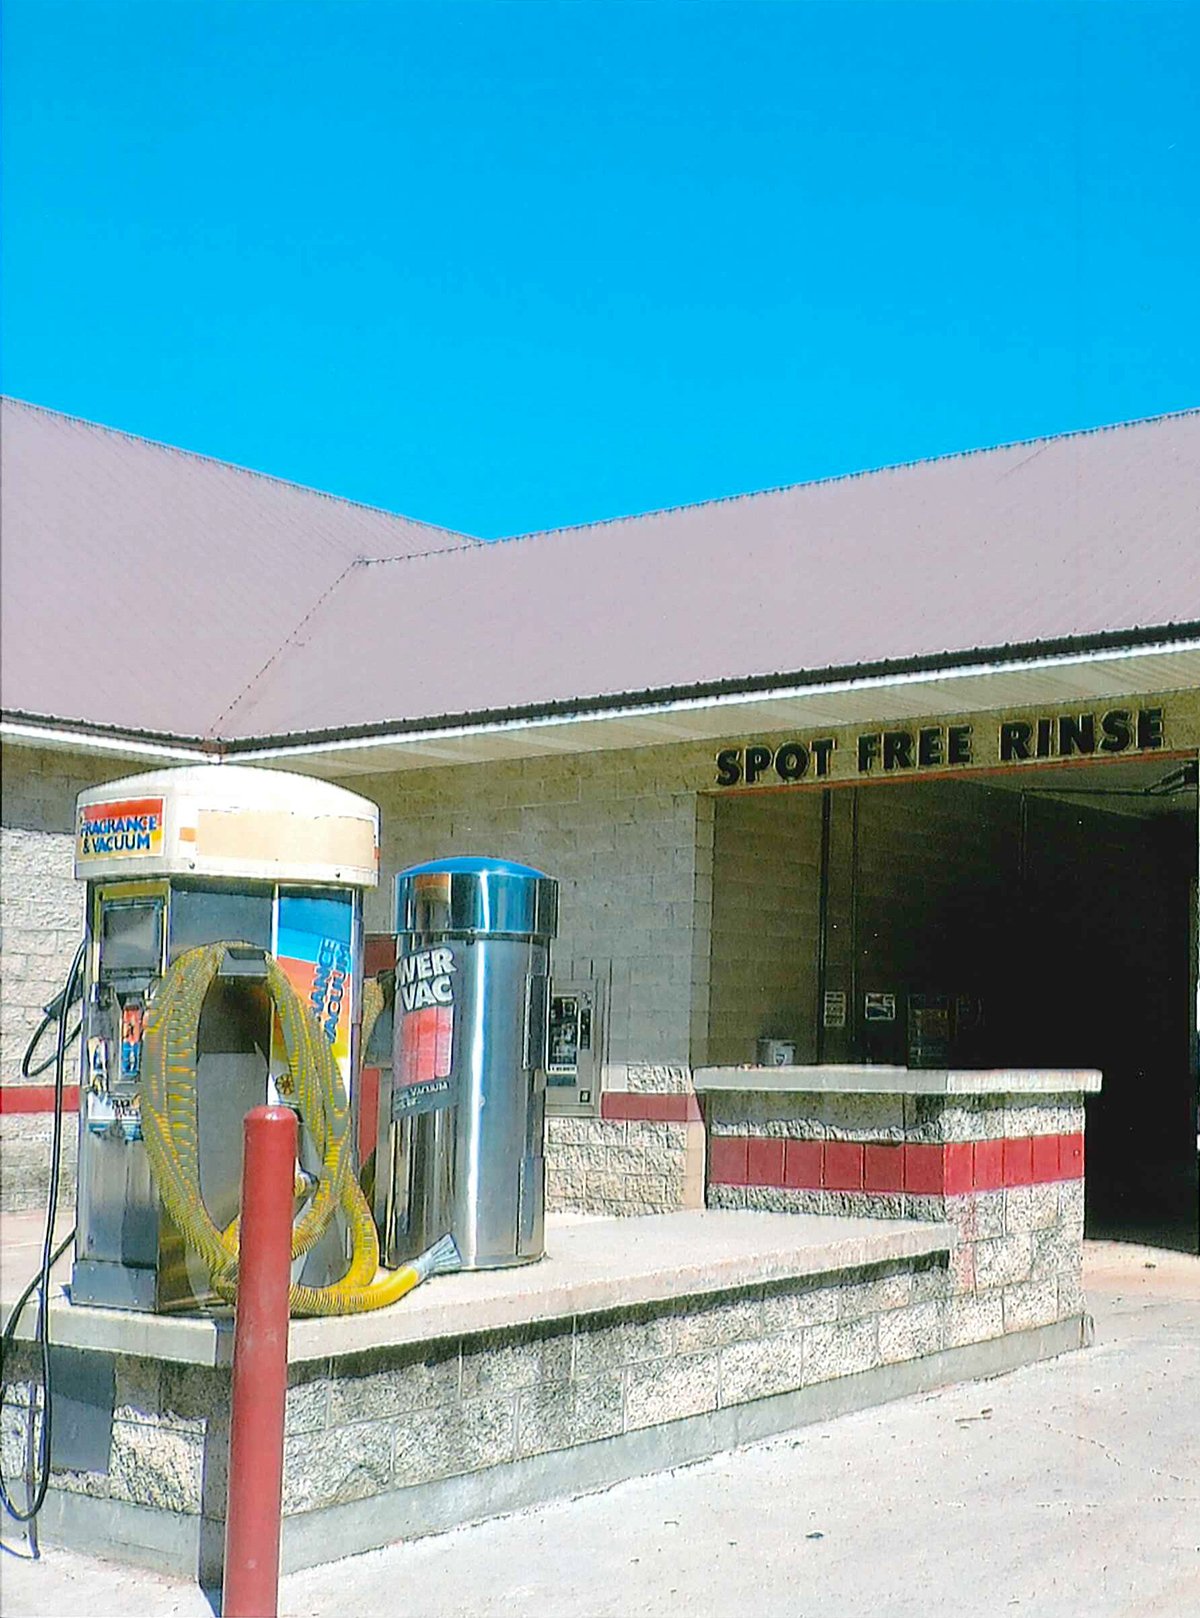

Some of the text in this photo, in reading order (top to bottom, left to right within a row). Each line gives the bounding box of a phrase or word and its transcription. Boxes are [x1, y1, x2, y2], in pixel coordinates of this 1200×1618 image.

[715, 707, 1165, 787] SPOT FREE RINSE
[80, 815, 157, 838] FRAGRANCE
[92, 832, 151, 854] VACUUM
[395, 947, 458, 990] WER
[323, 942, 352, 1044] VACUUM
[401, 975, 454, 1012] VAC
